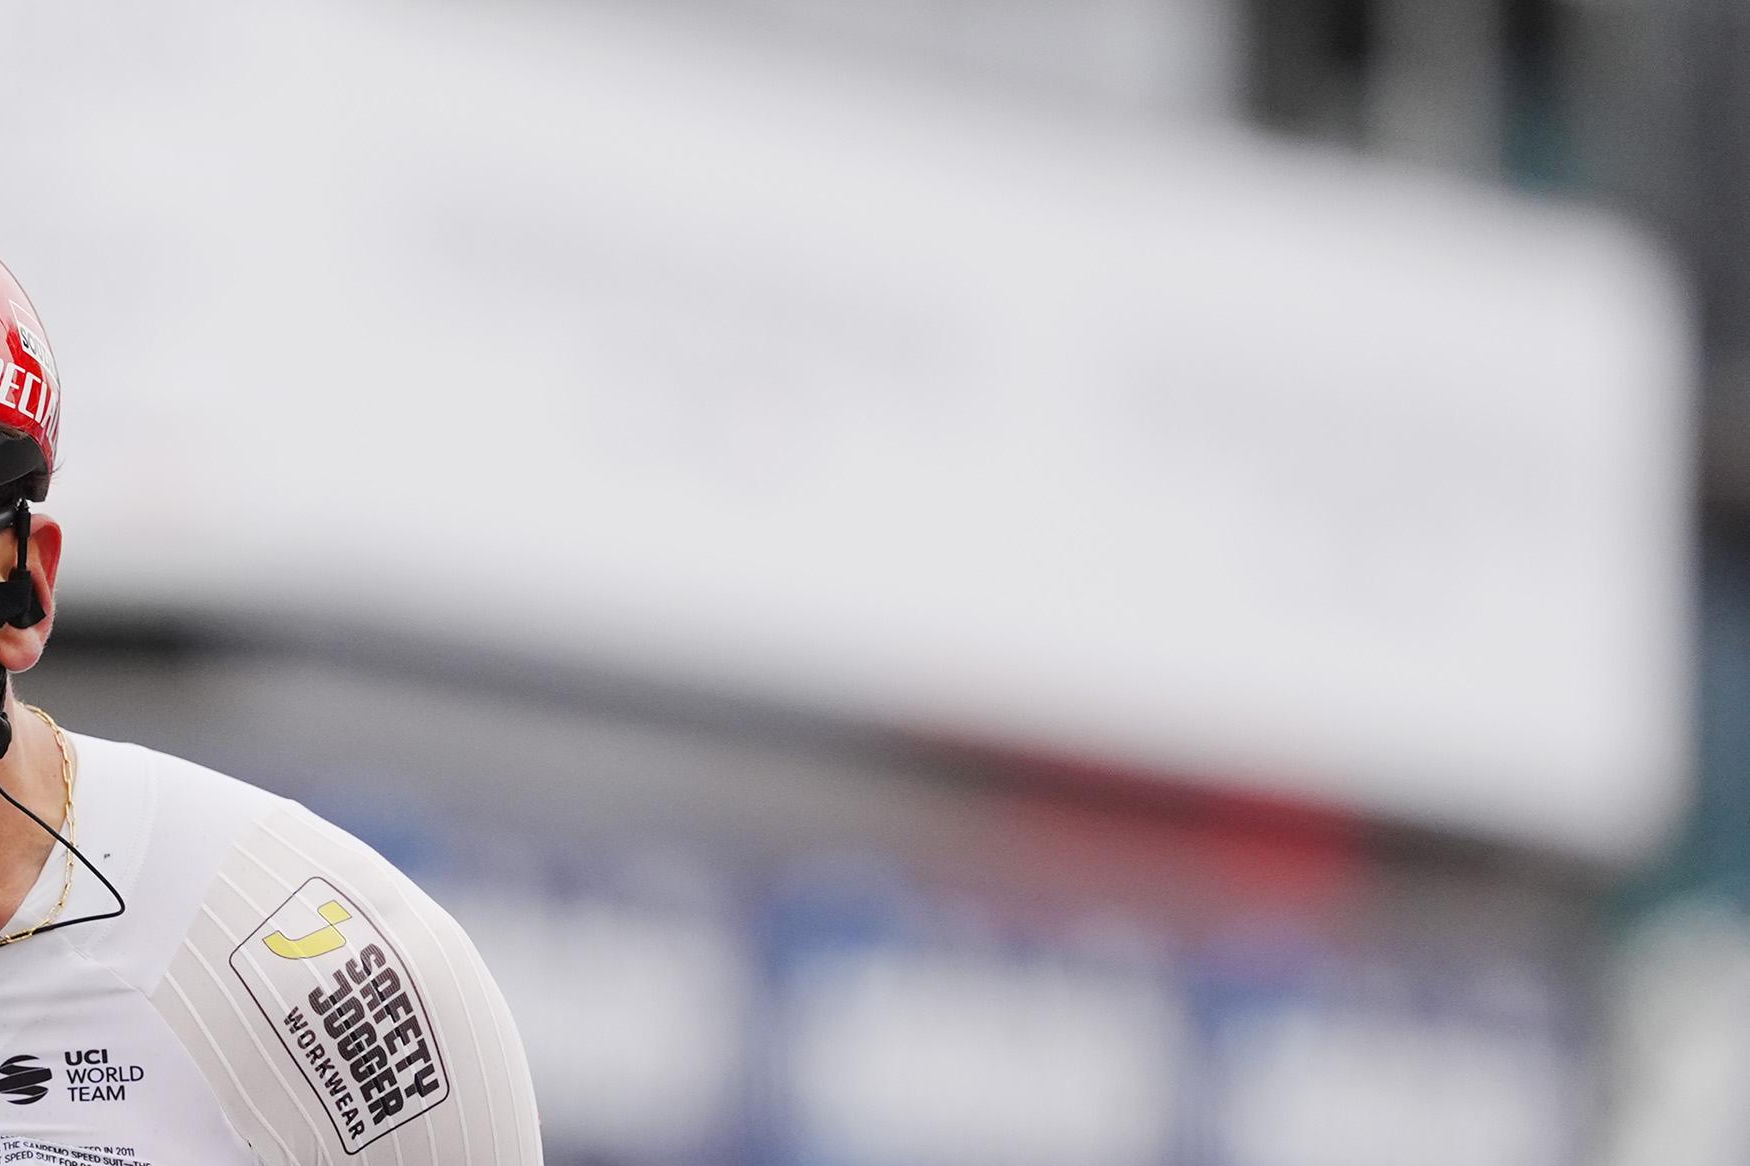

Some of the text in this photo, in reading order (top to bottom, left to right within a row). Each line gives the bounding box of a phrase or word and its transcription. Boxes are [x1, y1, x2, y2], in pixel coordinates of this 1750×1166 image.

[346, 943, 439, 1098] SAFETY
[308, 969, 404, 1125] JOGGER
[65, 1049, 108, 1066] UCI
[66, 1066, 144, 1084] WORLD
[284, 1006, 365, 1140] WORKWEAR
[67, 1085, 126, 1102] TEAM
[3, 1141, 20, 1151] THE
[71, 1150, 101, 1163] SPEED
[5, 1150, 34, 1163] SPEED
[36, 1151, 57, 1163] SUIT
[116, 1147, 135, 1156] 2011
